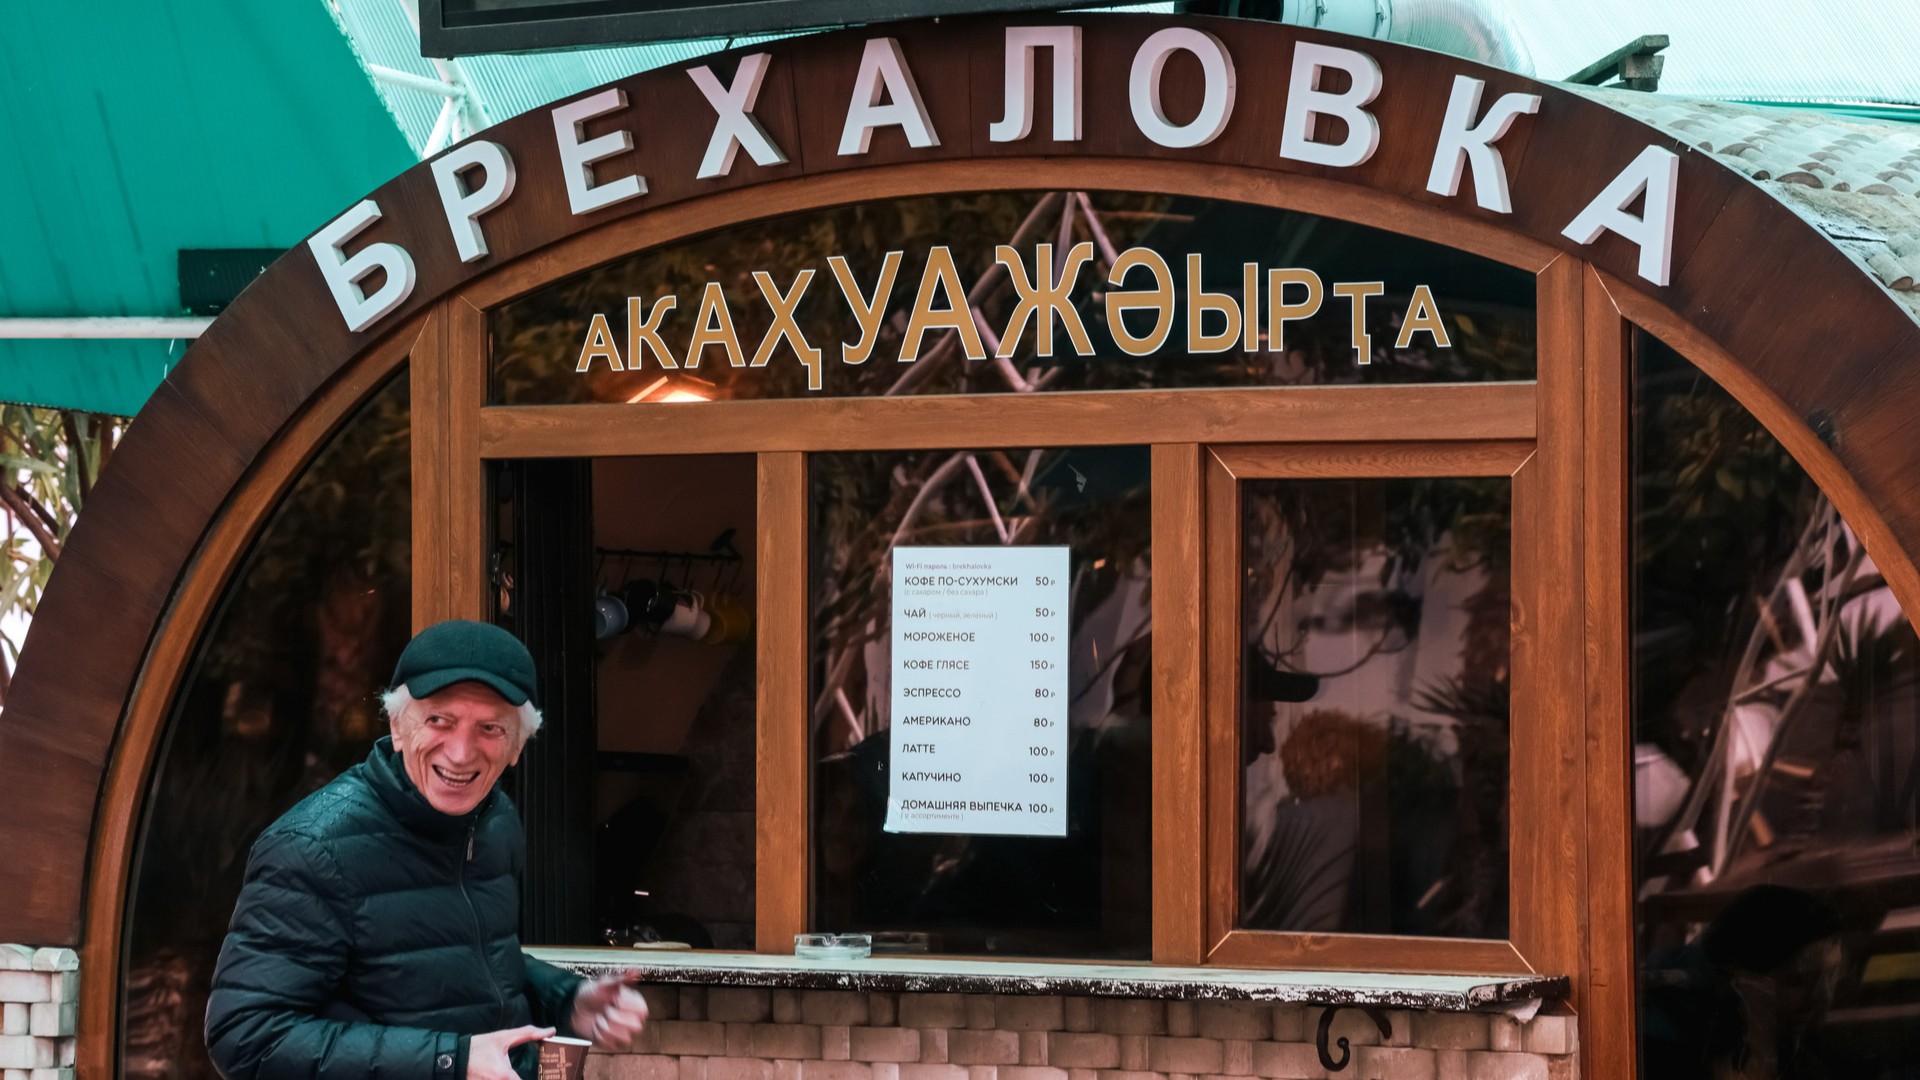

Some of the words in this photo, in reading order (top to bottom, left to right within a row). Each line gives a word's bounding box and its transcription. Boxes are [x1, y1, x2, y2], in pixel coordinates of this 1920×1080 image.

[307, 26, 1680, 333] БРЕХАЛОВКА
[905, 577, 934, 586] КОФЕ
[939, 577, 1018, 586] ПО-СУХУМСКИ
[904, 608, 926, 617] ЧАЙ
[904, 633, 975, 641] МОРОЖЕНОЕ
[904, 660, 933, 669] КОФЕ
[937, 661, 969, 669] ГЛЯСЕ
[904, 688, 961, 697] ЭСПРЕССО
[903, 717, 971, 726] АМЕРИКАНО
[902, 744, 935, 753] ЛАТТЕ
[902, 772, 961, 782] КАПУЧИНО
[901, 800, 966, 811] ДОМАШНЯЯ
[970, 802, 1022, 812] ВЫПЕЧКА
